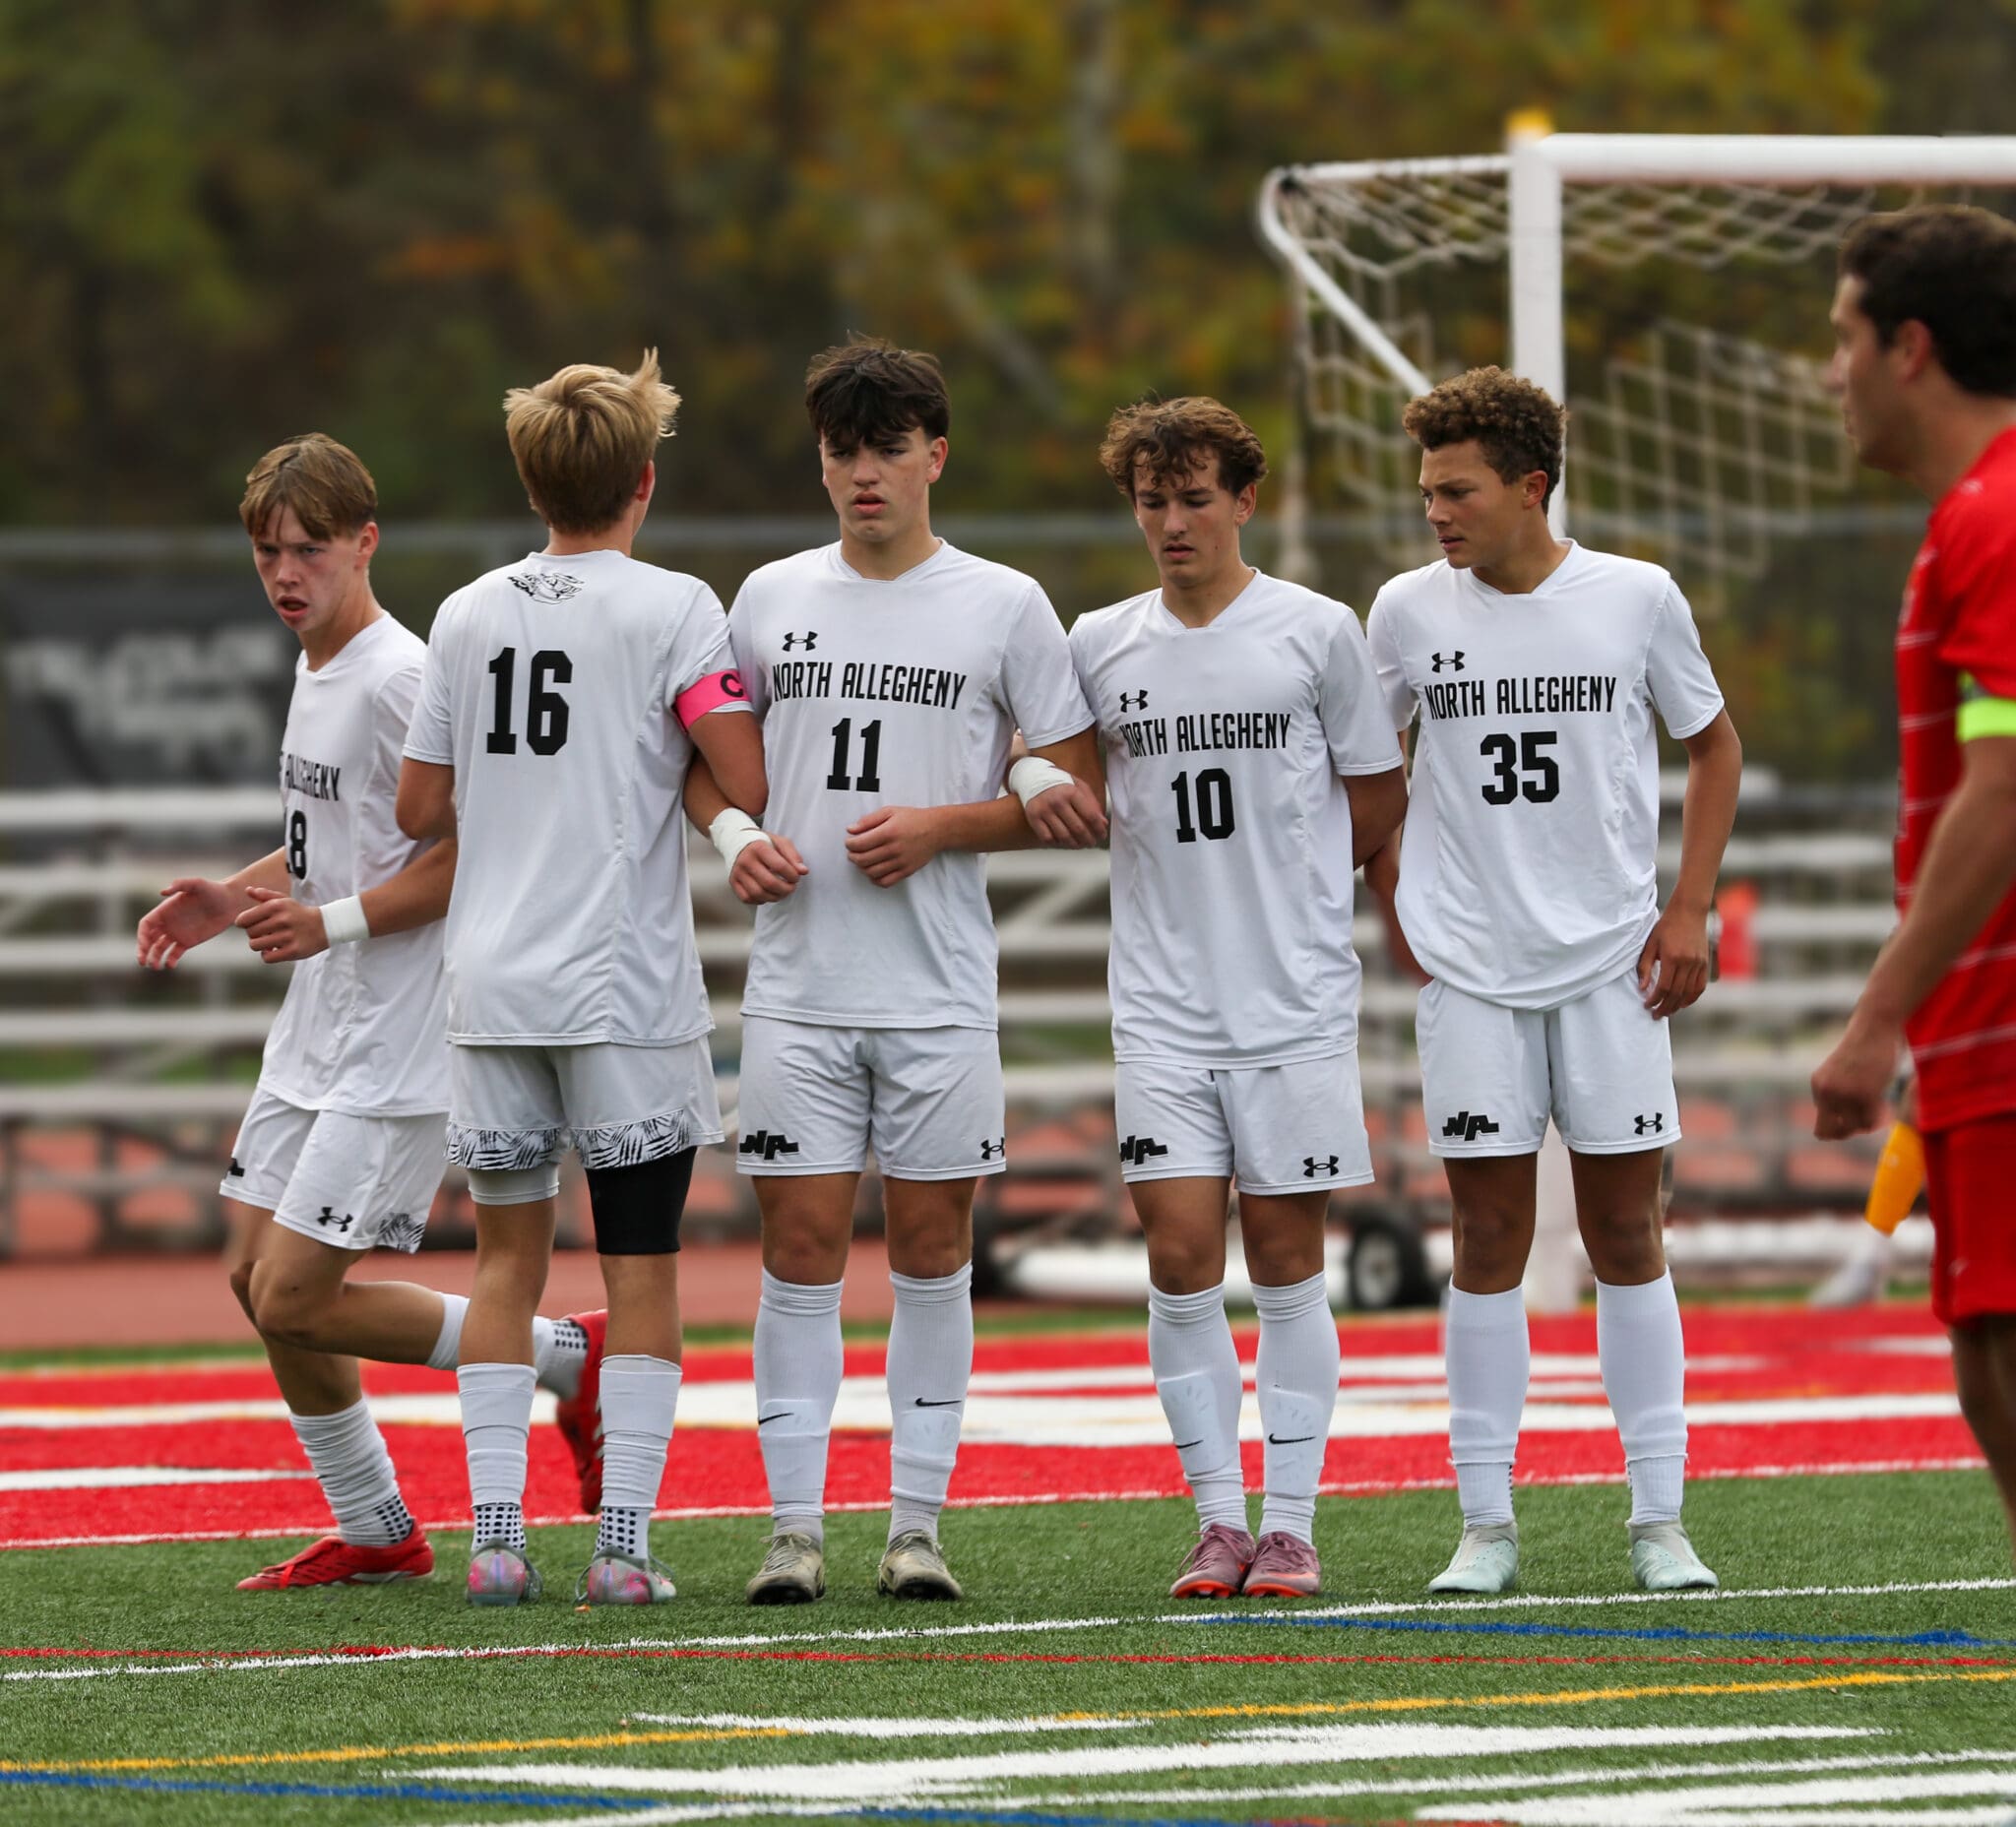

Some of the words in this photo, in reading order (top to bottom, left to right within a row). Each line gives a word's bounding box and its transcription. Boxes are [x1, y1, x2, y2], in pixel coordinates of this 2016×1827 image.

[486, 647, 573, 756] 16
[720, 673, 744, 698] C
[773, 662, 833, 702] NORTH
[842, 662, 968, 710] ALLEGHENY
[1424, 679, 1485, 720] NORTH
[1496, 676, 1617, 715] ALLEGHENY
[826, 718, 882, 792] 11
[1176, 713, 1291, 753] ALLEGHENY
[1480, 730, 1560, 805] 35
[1170, 768, 1235, 844] 10
[284, 807, 307, 880] 8
